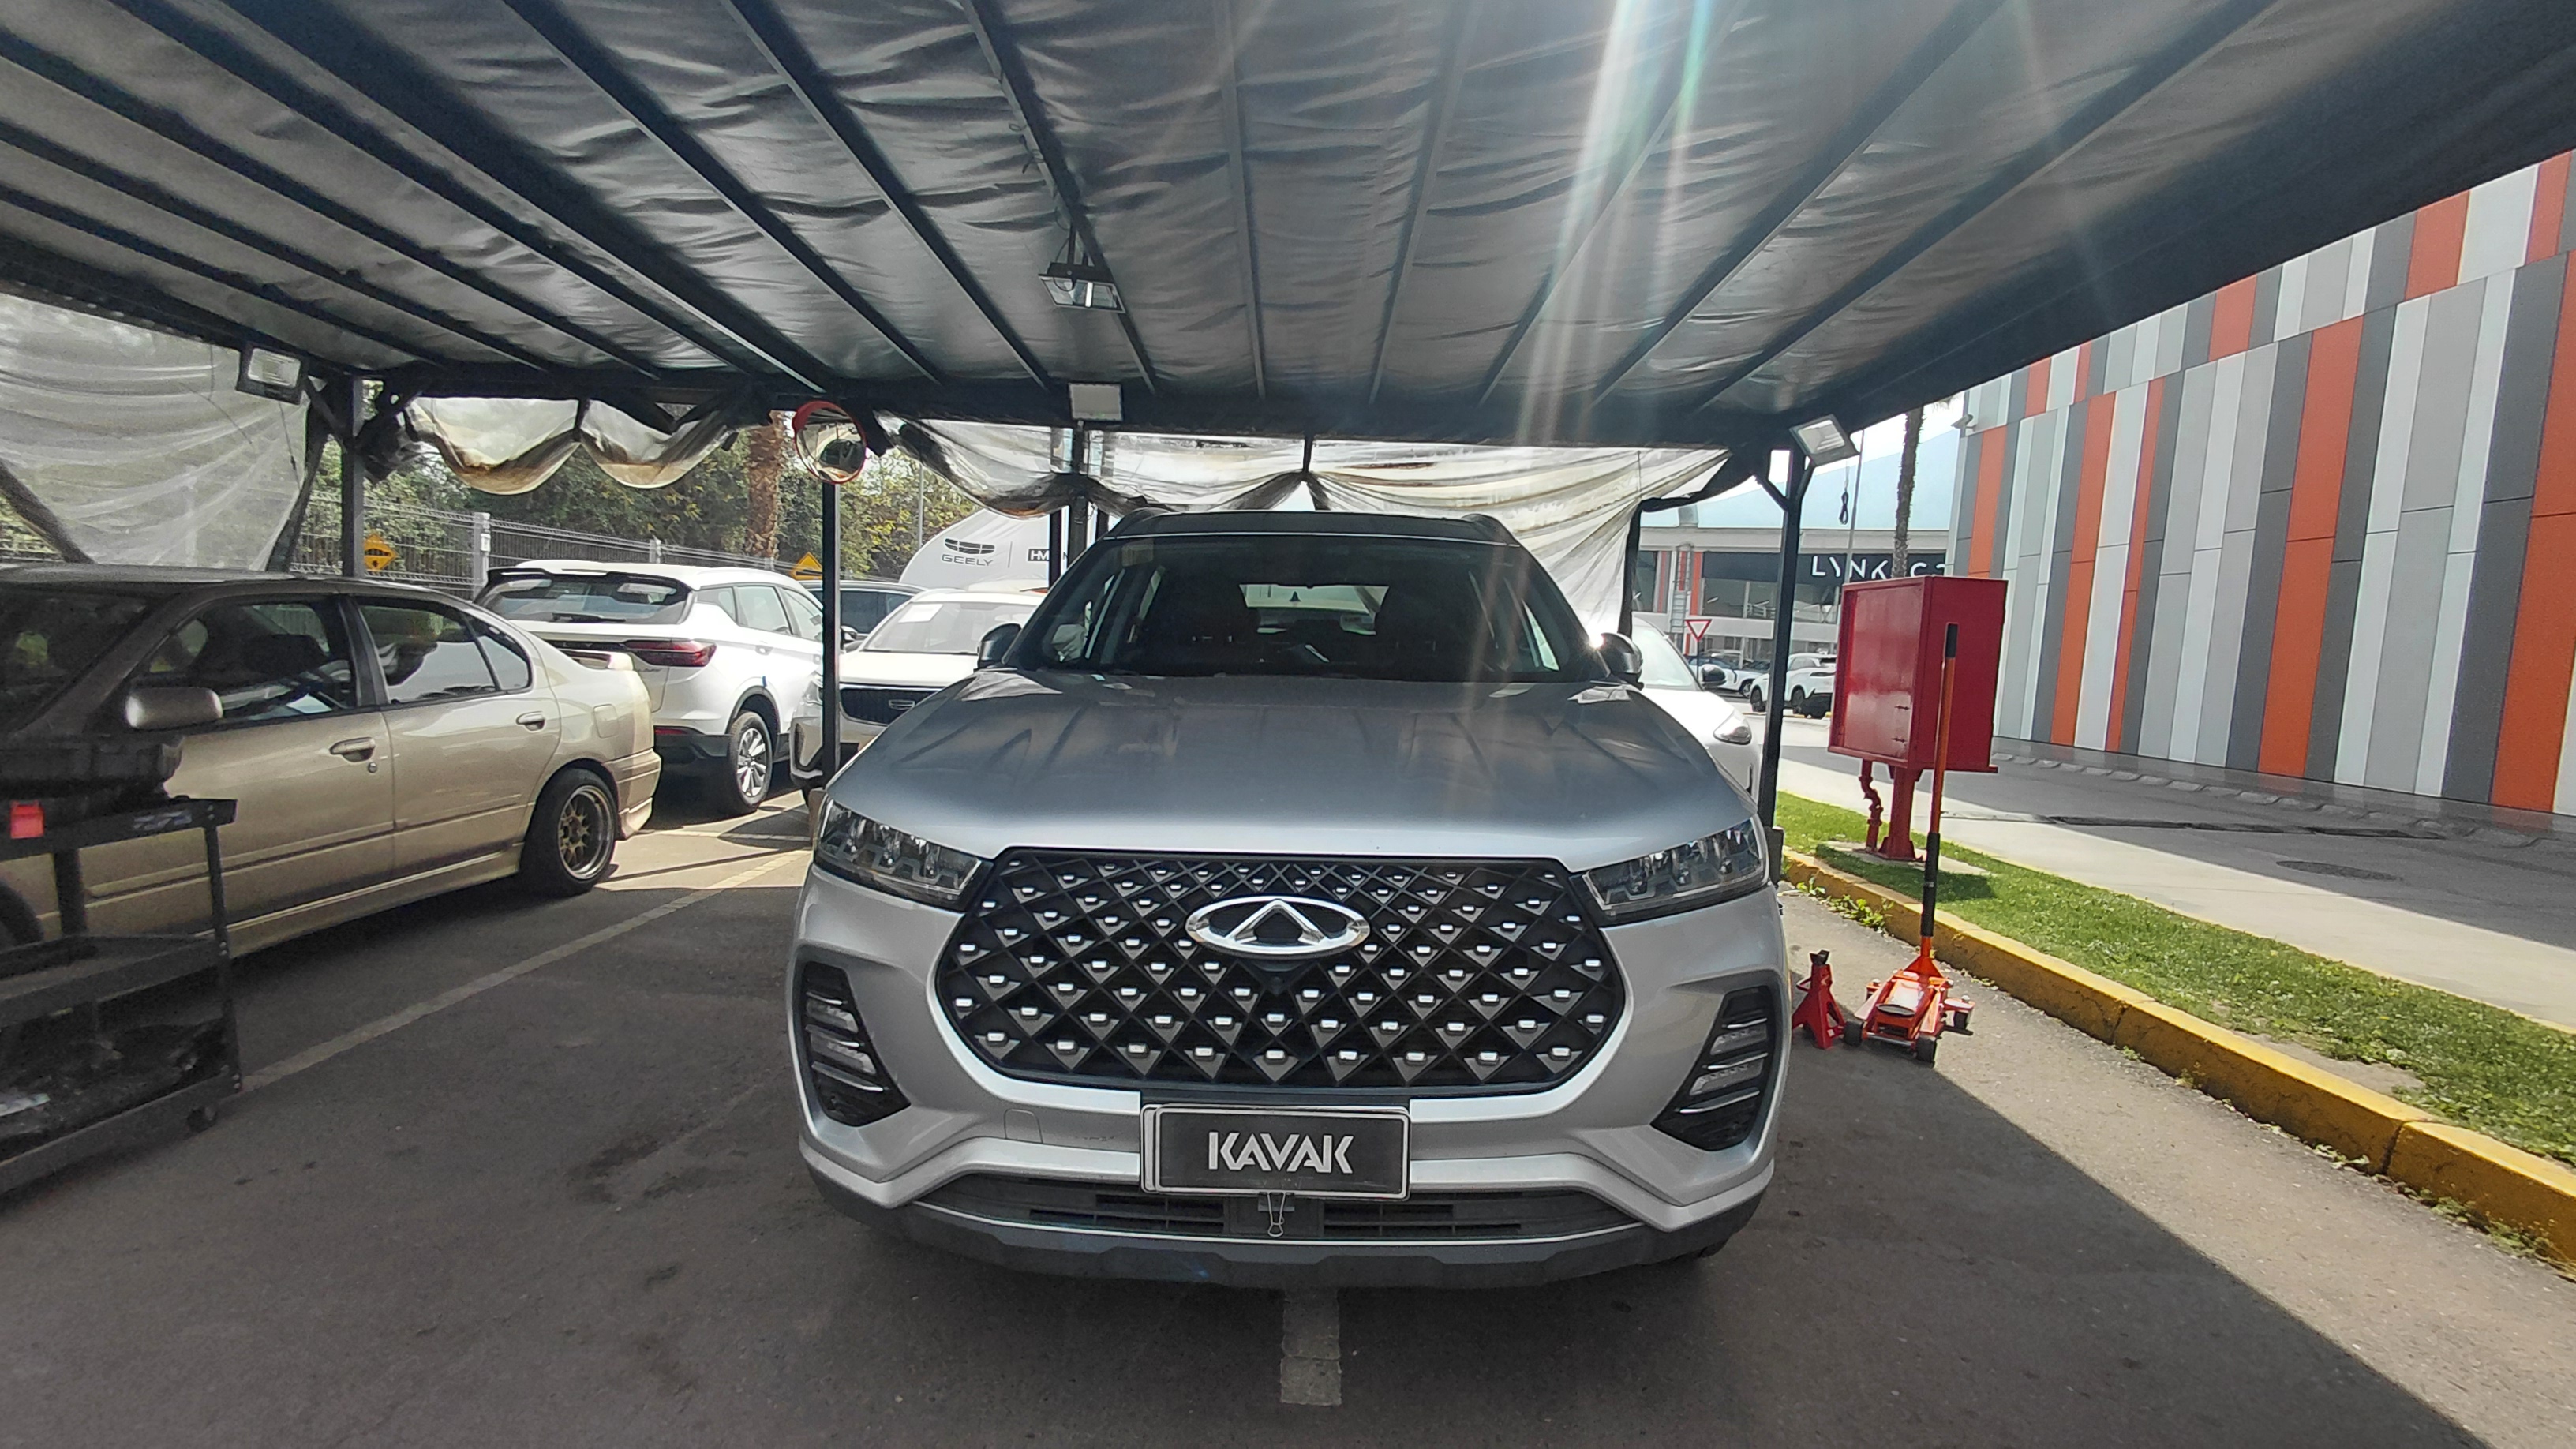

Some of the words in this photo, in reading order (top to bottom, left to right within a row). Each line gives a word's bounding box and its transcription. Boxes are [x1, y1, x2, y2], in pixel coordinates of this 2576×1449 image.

[942, 554, 994, 567] GEELY
[1812, 556, 1888, 580] LYNK
[1208, 1132, 1354, 1174] KAVAK
